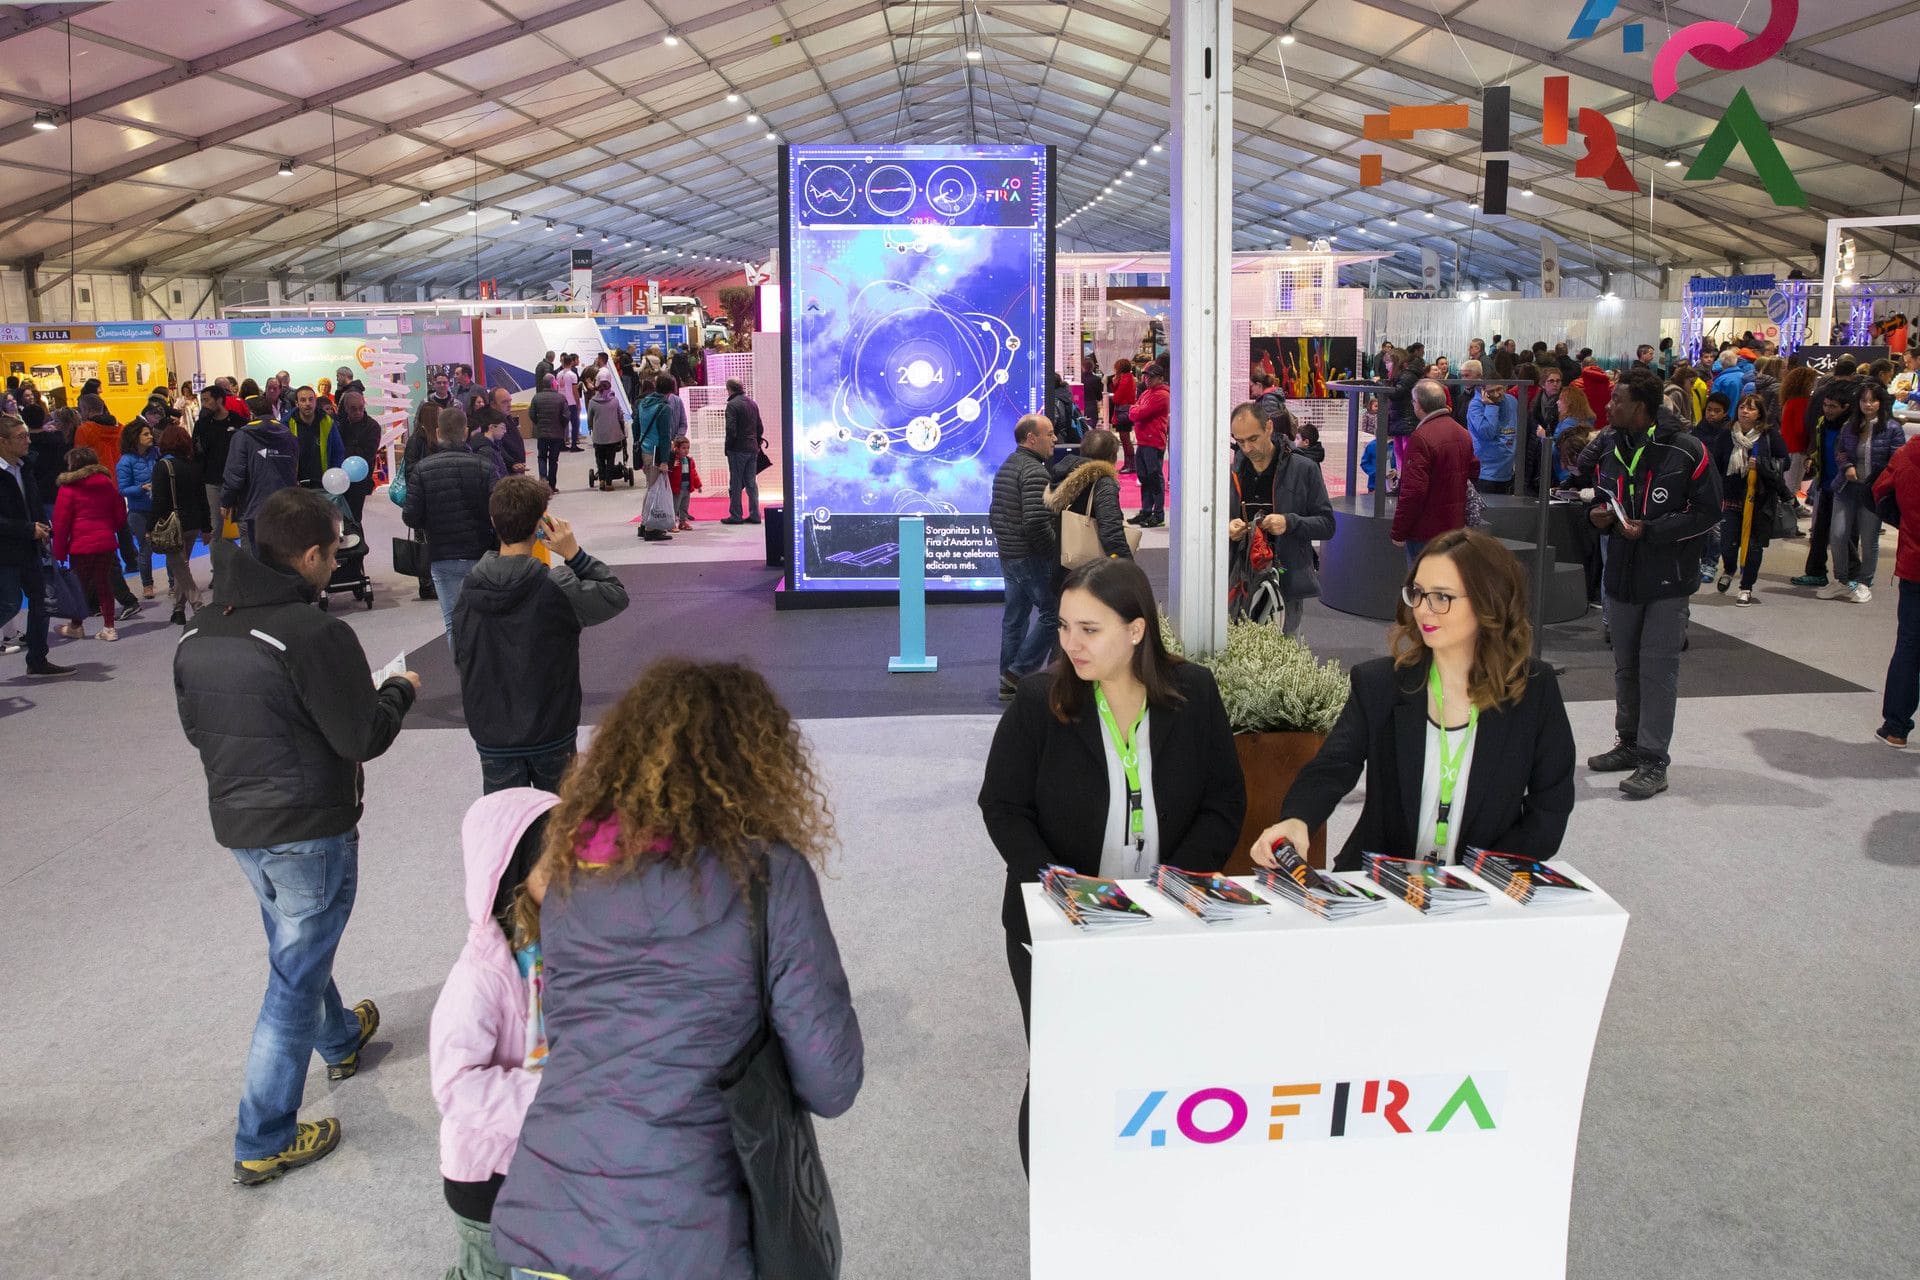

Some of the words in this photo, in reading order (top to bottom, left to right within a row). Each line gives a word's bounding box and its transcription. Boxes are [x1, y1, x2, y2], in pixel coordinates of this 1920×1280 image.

[985, 189, 1021, 203] FIRA
[34, 330, 69, 341] SAULA
[925, 525, 970, 537] S'organitza
[971, 525, 980, 535] la
[925, 537, 941, 546] Fira
[943, 536, 983, 546] d'Andorra
[985, 536, 993, 546] la
[925, 548, 934, 558] la
[935, 549, 951, 560] què
[925, 560, 958, 570] edicions
[959, 561, 978, 570] més.
[1267, 1074, 1498, 1141] FIRA
